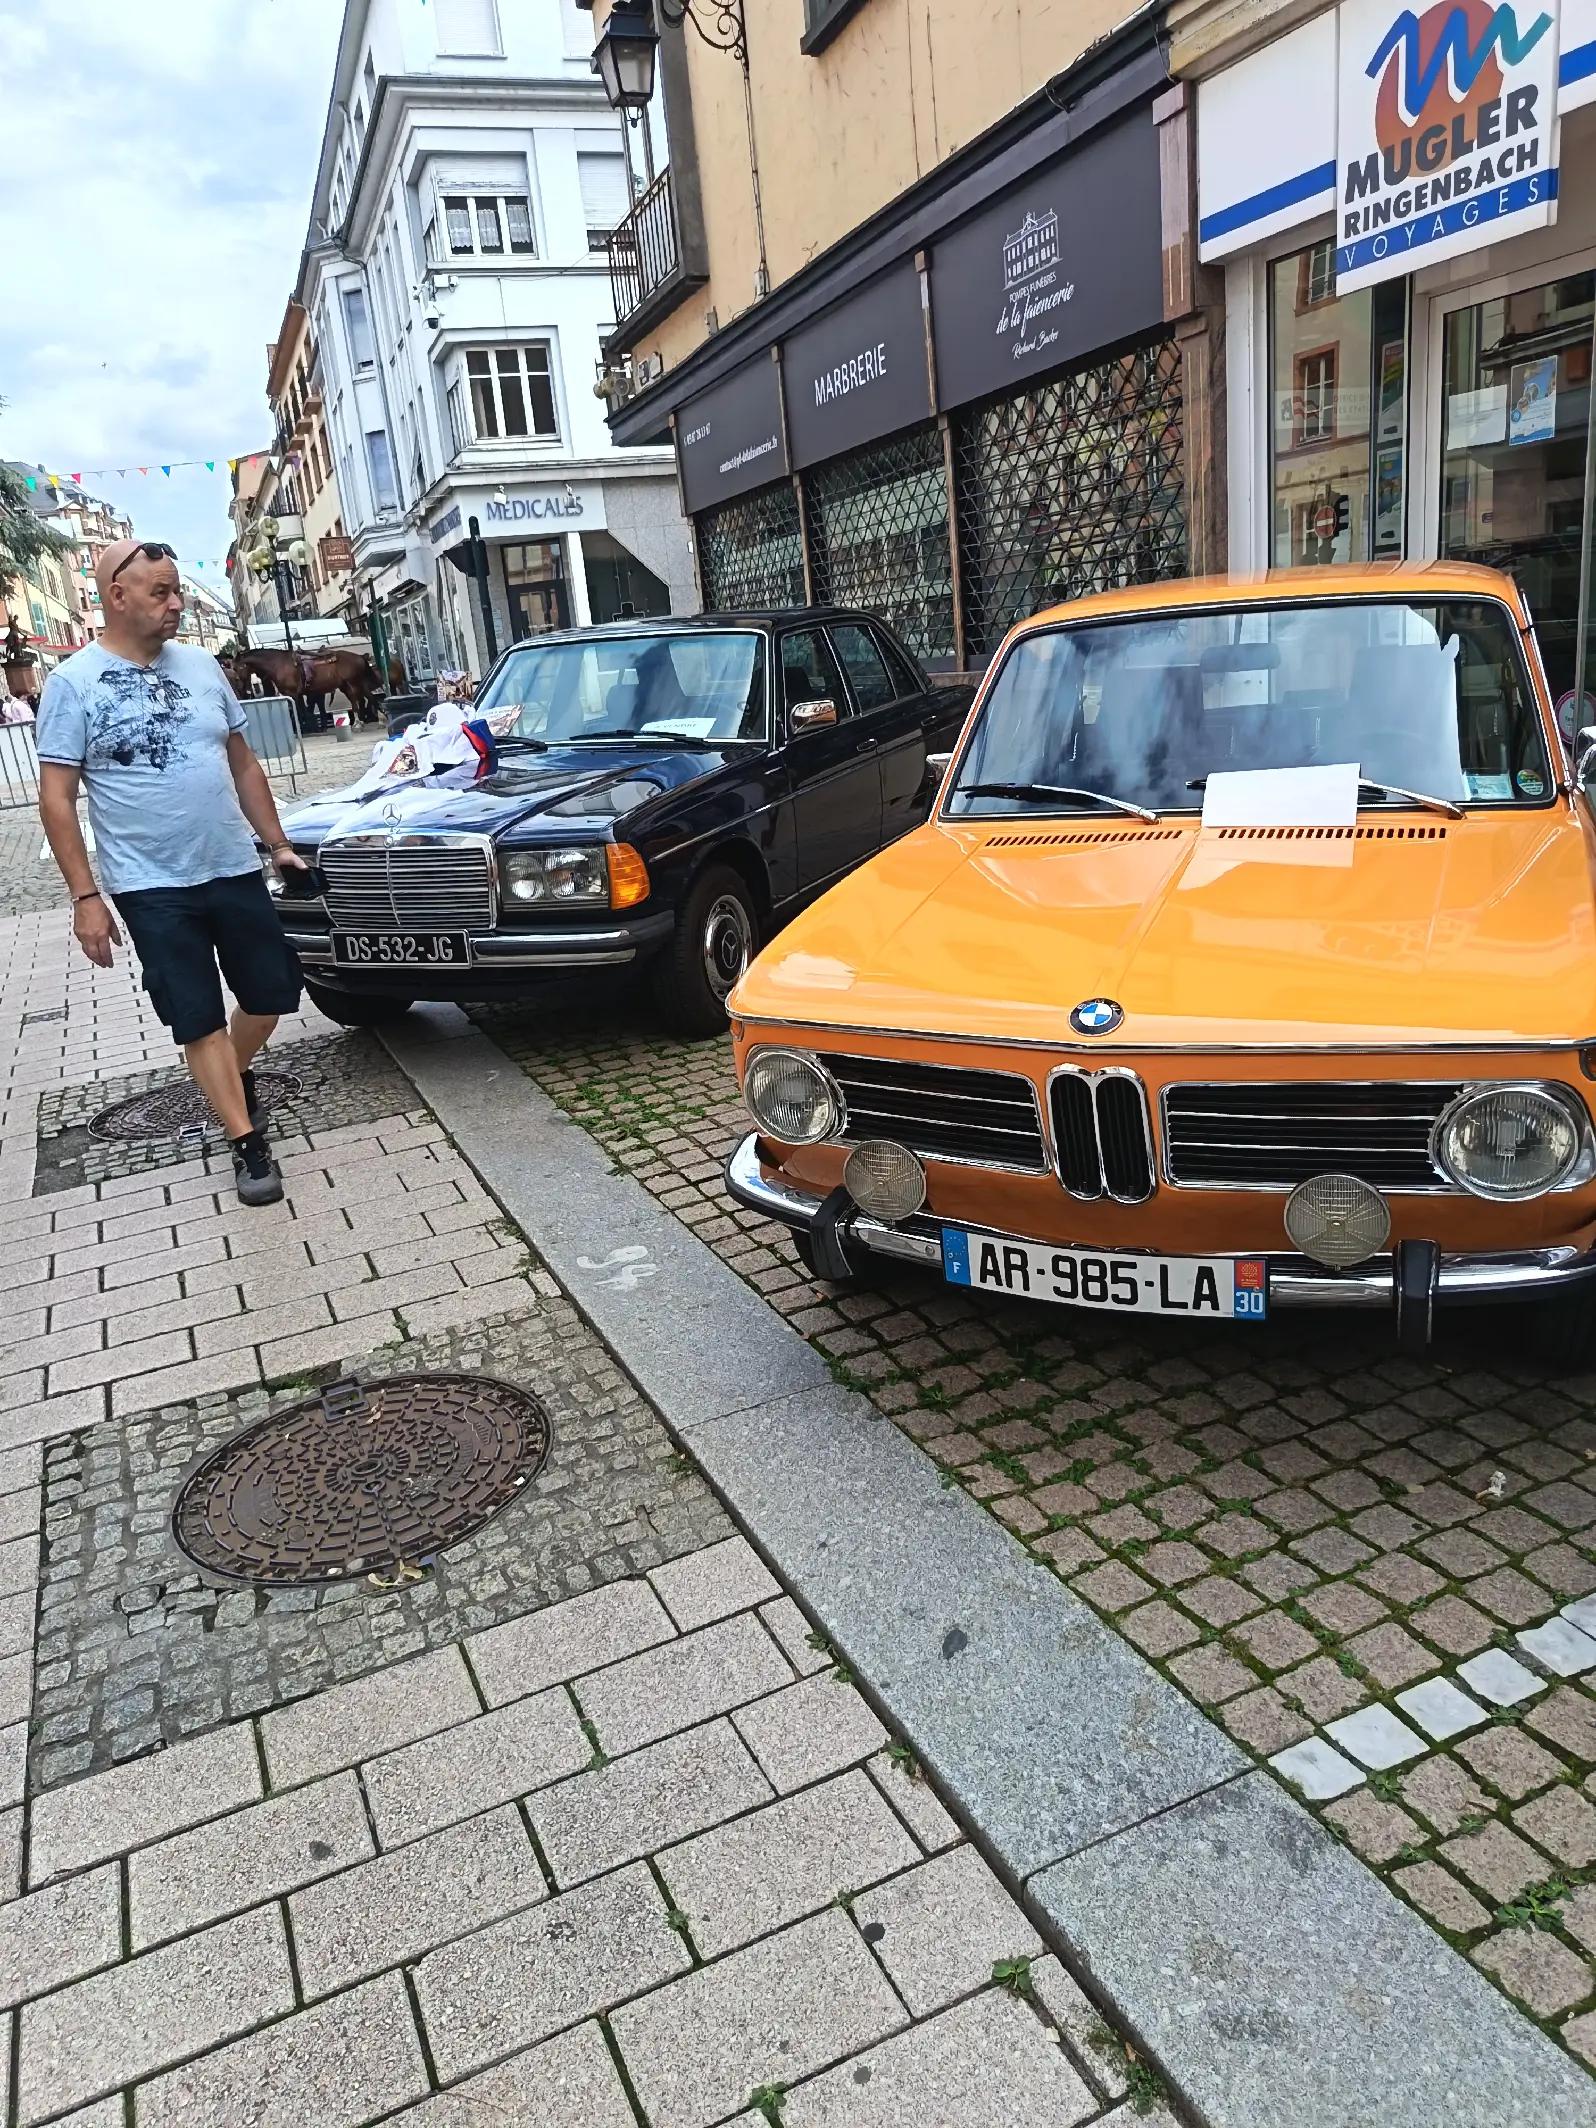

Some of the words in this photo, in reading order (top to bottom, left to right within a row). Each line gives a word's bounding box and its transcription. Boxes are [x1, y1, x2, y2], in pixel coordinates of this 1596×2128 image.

[1344, 83, 1539, 205] MUGLER
[1344, 137, 1539, 239] RINGENBACH
[1345, 177, 1539, 268] VOYAGES
[996, 306, 1009, 334] de
[1010, 302, 1021, 327] la
[814, 342, 887, 407] MARBRERIE
[346, 936, 454, 961] DS-532-JG
[952, 1261, 961, 1274] F
[979, 1242, 1220, 1311] AR-985-LA
[1235, 1291, 1263, 1314] 30
